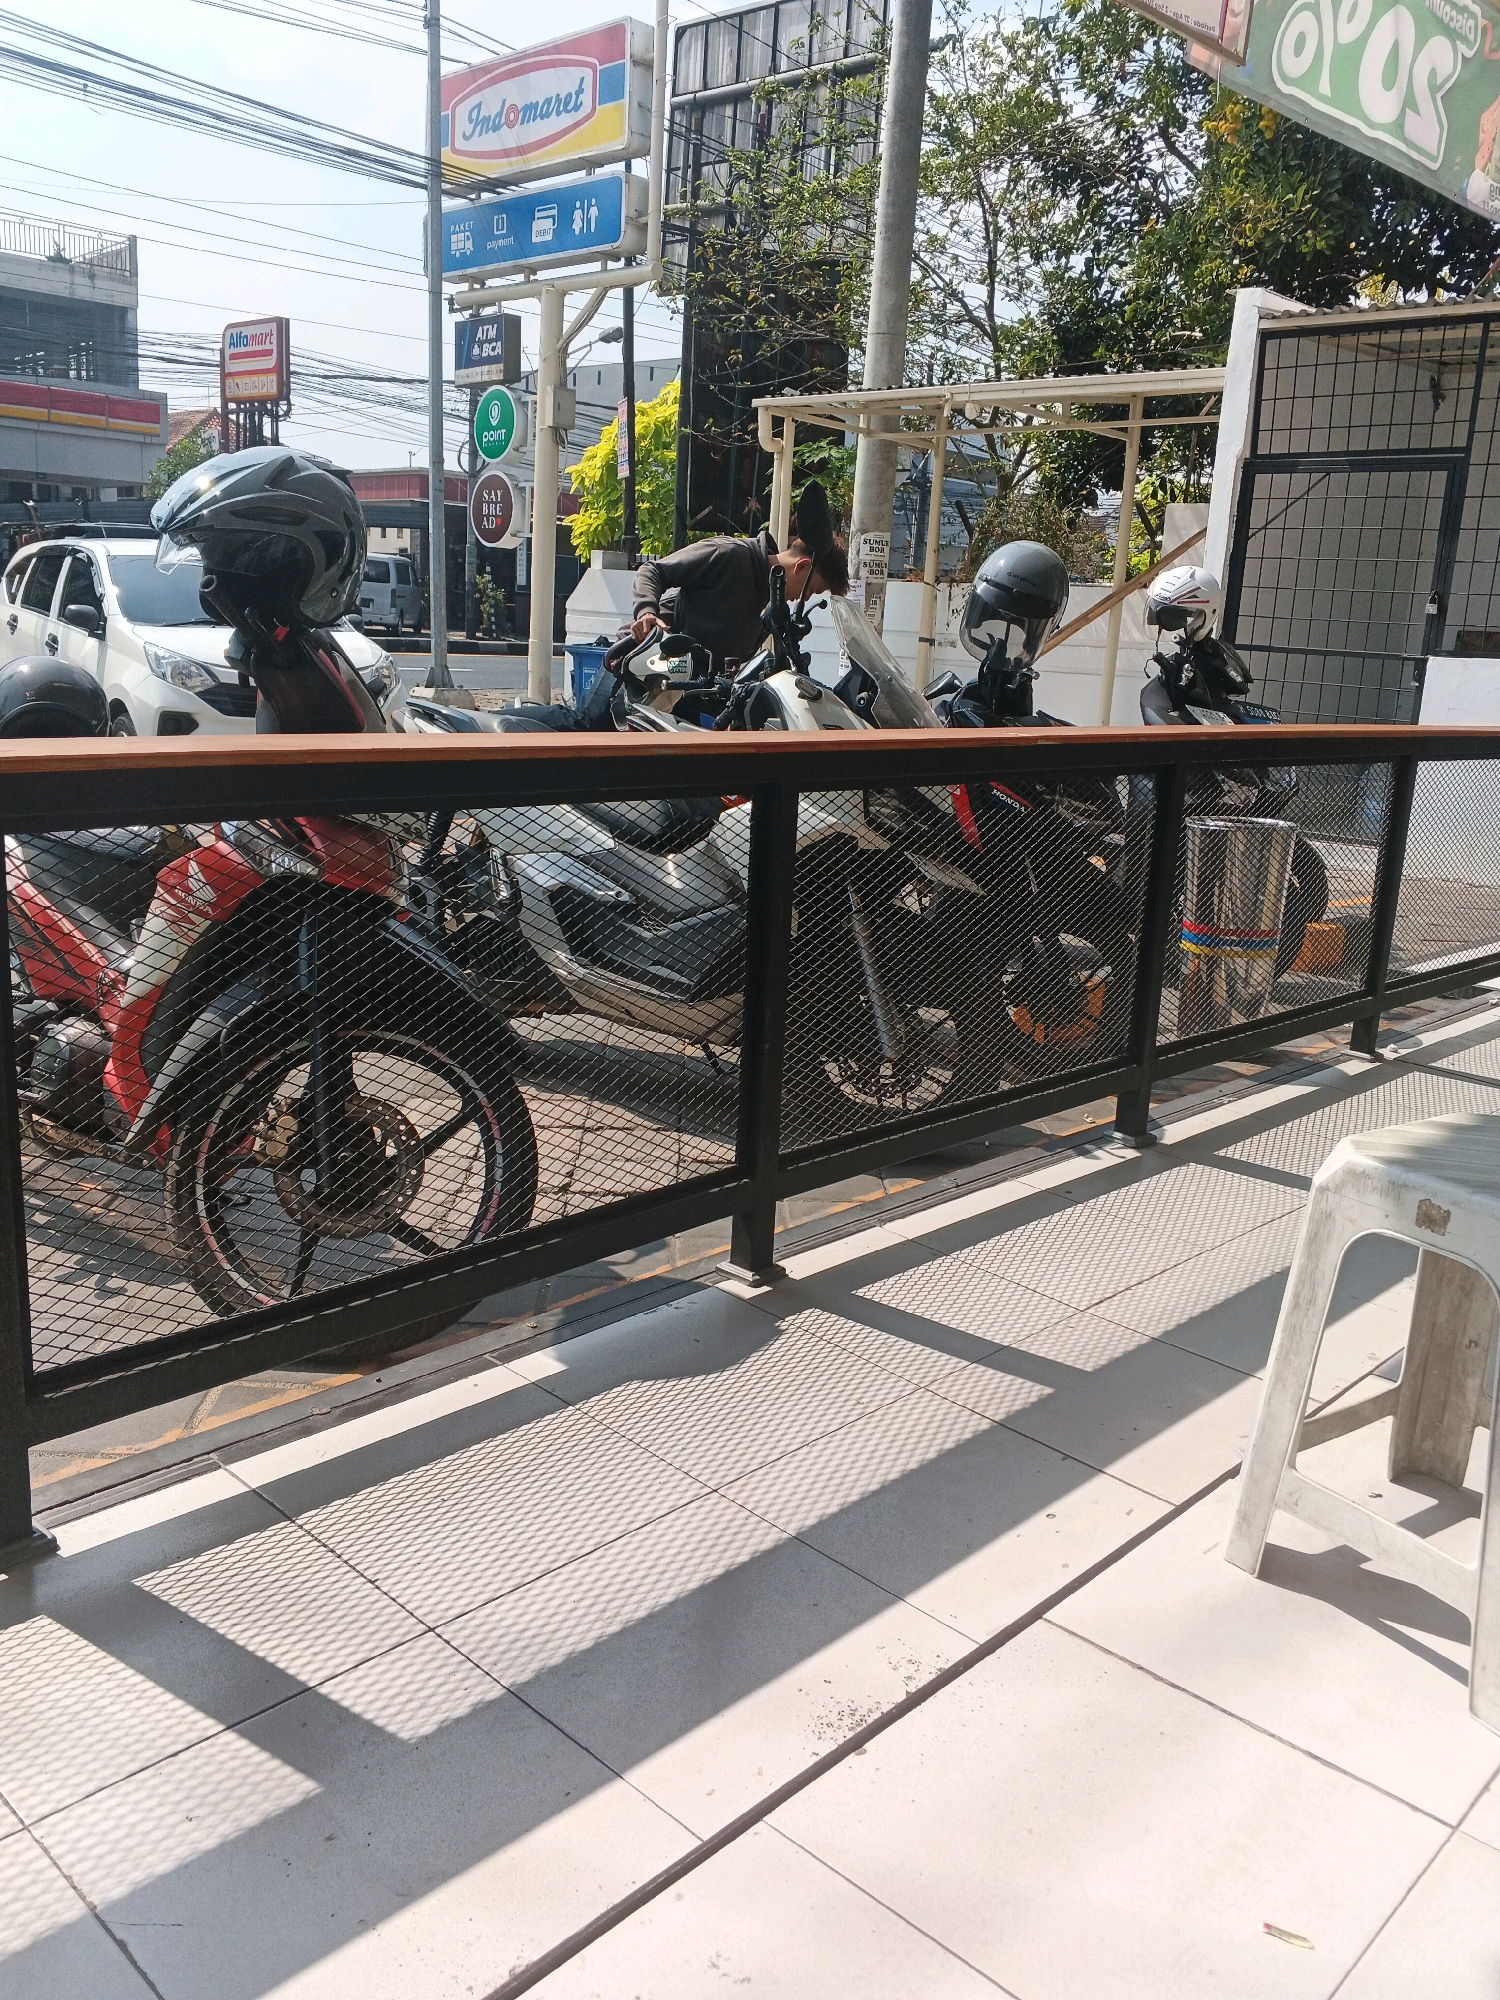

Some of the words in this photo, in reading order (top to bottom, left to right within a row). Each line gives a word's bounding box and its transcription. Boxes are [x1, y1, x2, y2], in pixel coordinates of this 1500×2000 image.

[462, 76, 585, 142] Indomaret
[450, 221, 474, 233] PAKET
[535, 227, 552, 238] DEBIT
[486, 235, 514, 251] payment
[228, 328, 274, 350] Alfamart
[475, 323, 498, 342] ATM
[481, 341, 502, 358] BCA
[482, 489, 503, 502] SAY
[482, 502, 503, 516] BRE
[481, 516, 496, 529] AD
[868, 545, 885, 554] BOR
[990, 788, 1026, 813] HONDA
